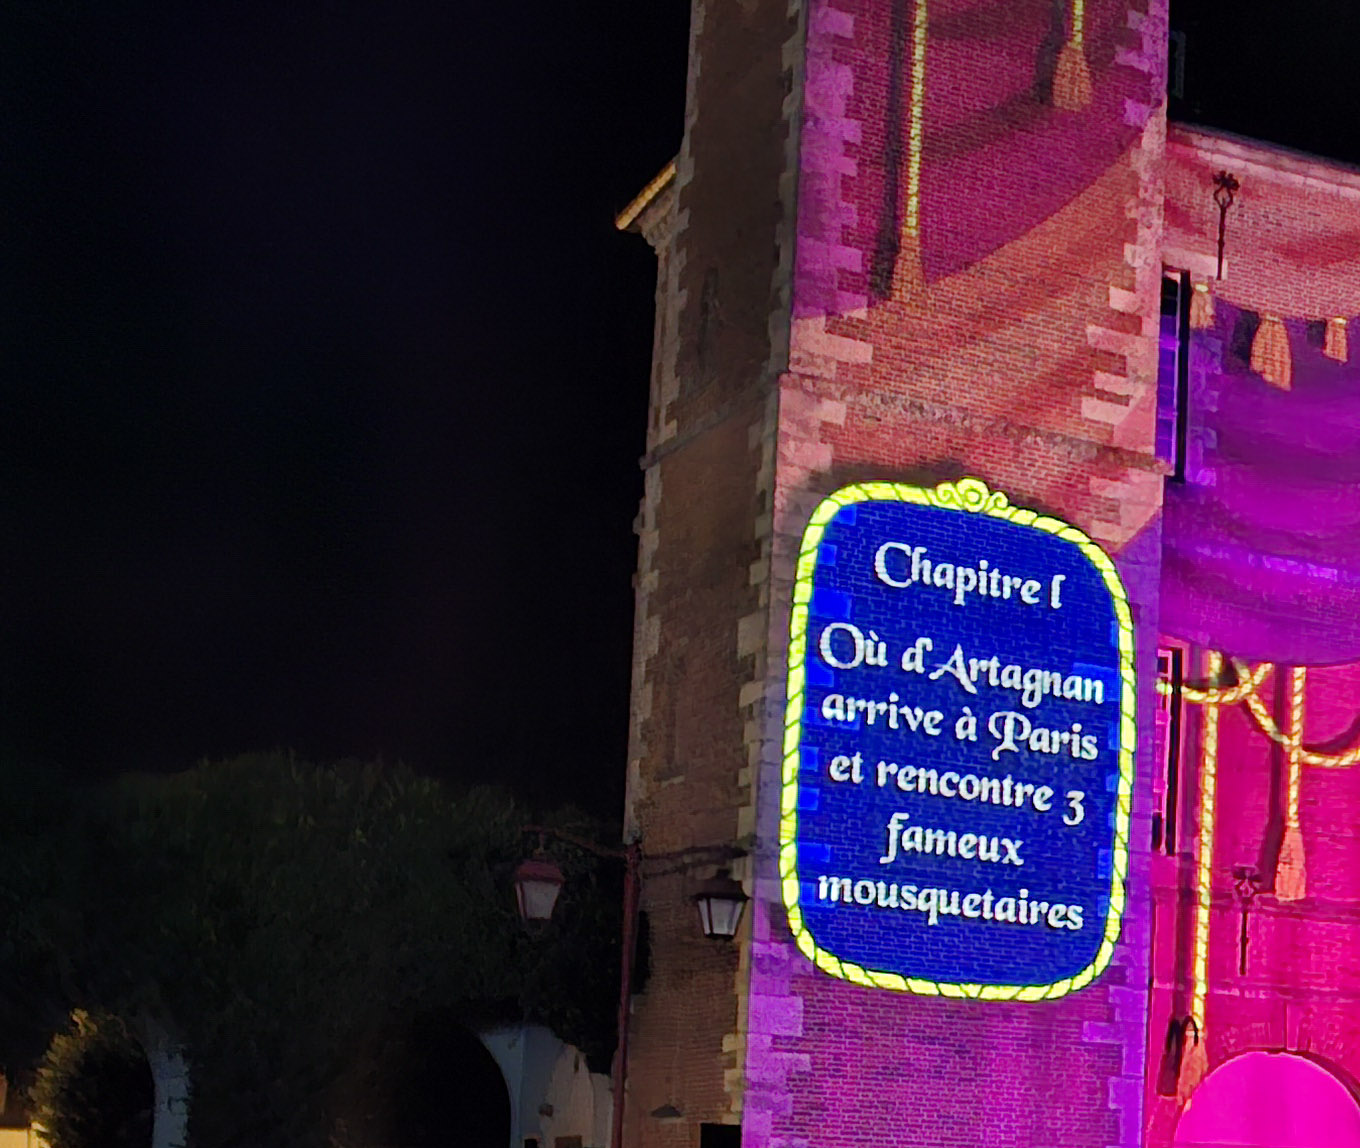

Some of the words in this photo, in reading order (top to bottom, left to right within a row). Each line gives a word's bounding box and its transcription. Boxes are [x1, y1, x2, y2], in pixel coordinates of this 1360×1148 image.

[874, 541, 1042, 606] Chapitre
[818, 622, 888, 669] Où
[901, 636, 1104, 709] d'Artagnan
[821, 692, 943, 736] arrive
[955, 706, 978, 742] à
[988, 711, 1099, 761] Paris
[829, 751, 863, 784] et
[877, 760, 1054, 812] rencontre
[1062, 790, 1086, 826] 3
[879, 812, 1025, 866] fameux
[817, 875, 1084, 930] mousquetaires
